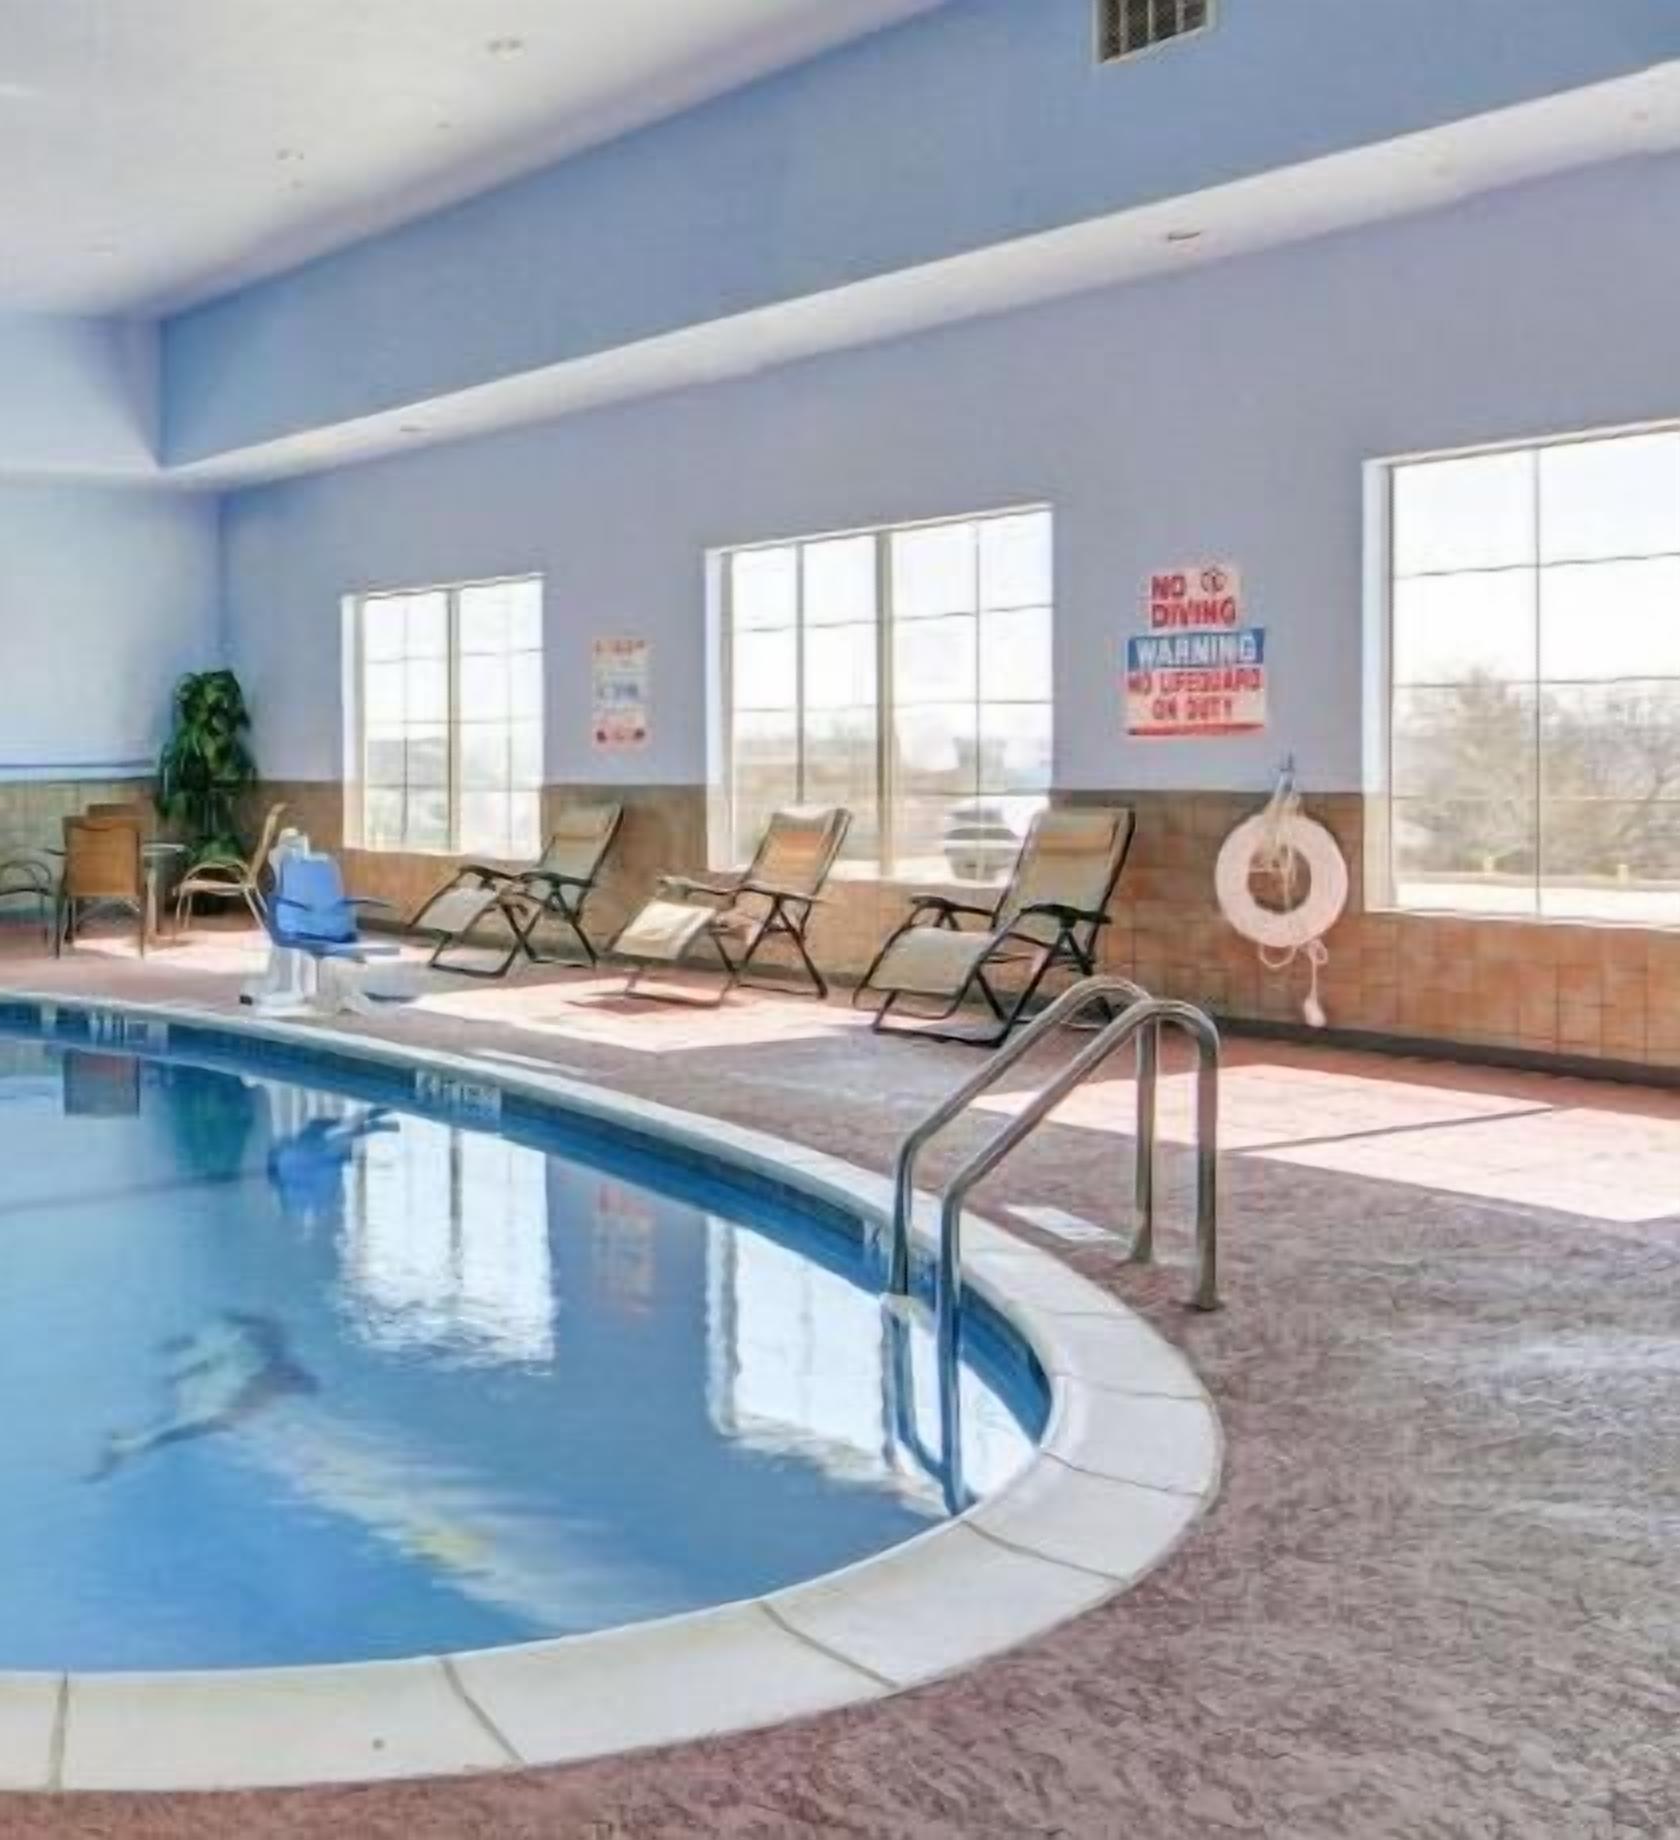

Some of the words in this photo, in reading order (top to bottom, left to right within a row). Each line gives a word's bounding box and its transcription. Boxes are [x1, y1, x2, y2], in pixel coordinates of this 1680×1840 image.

[1152, 574, 1186, 598] NO
[1152, 597, 1237, 627] DIVING
[1135, 634, 1258, 667] WARNING
